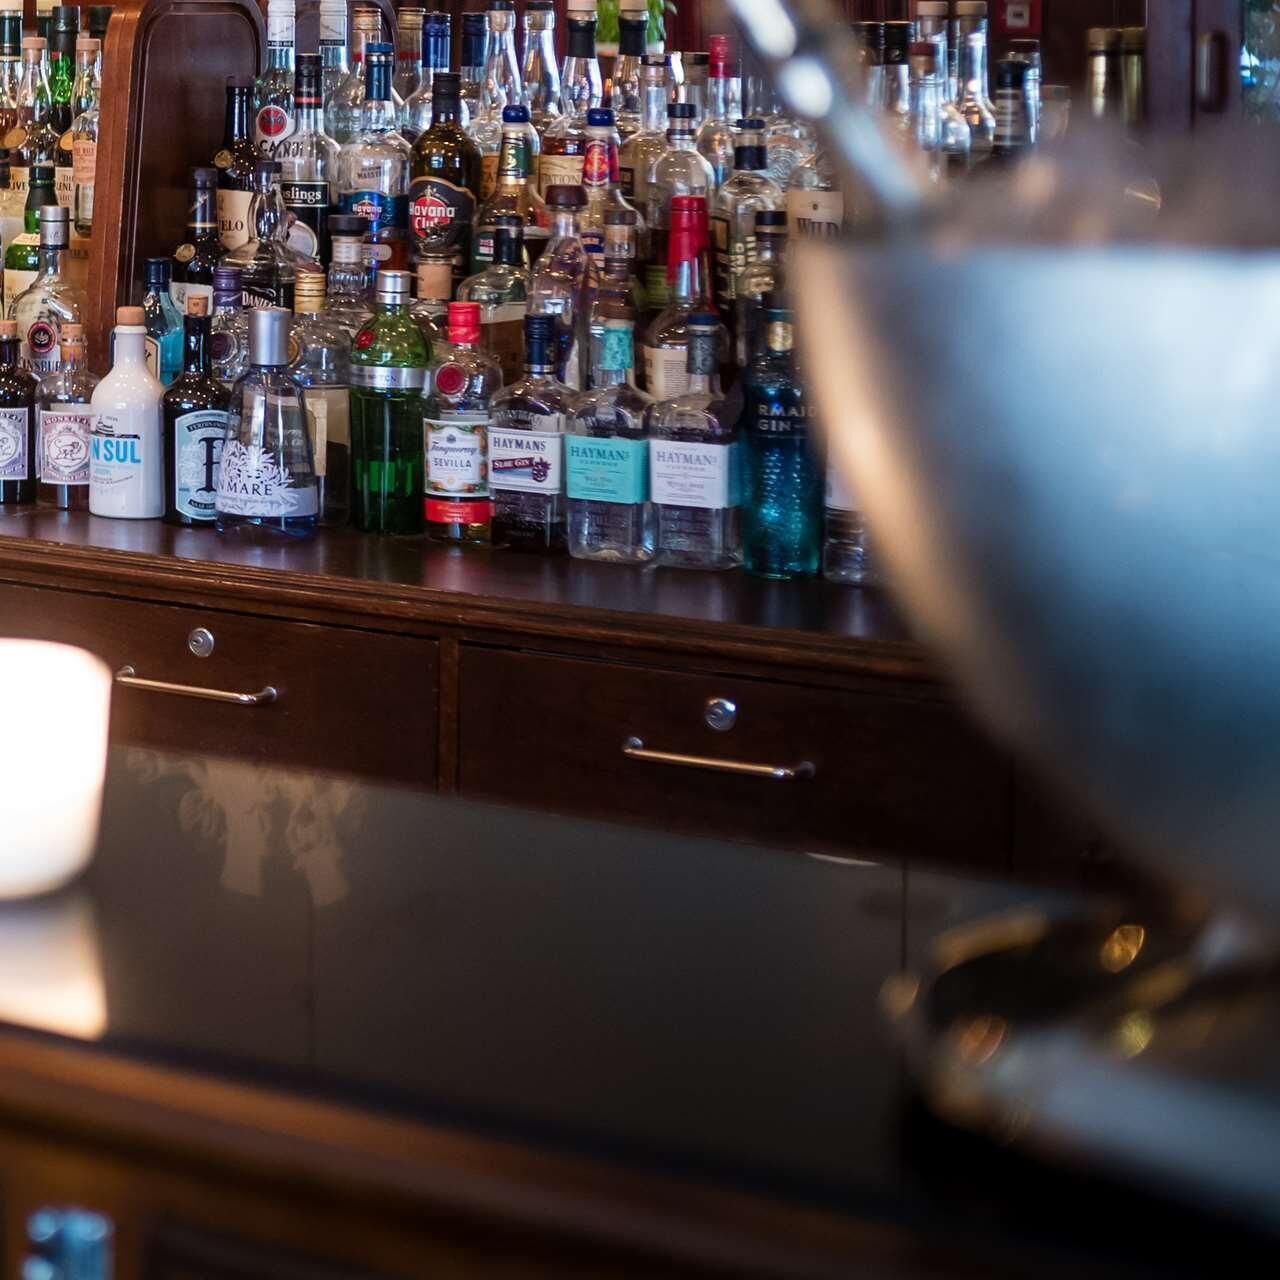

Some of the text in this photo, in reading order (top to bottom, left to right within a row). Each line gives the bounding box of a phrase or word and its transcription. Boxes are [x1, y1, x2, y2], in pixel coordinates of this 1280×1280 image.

[285, 186, 322, 203] slings
[408, 201, 456, 218] Havana
[757, 404, 817, 417] RMAID
[103, 438, 142, 464] SUL
[433, 457, 472, 468] SEVILLA
[228, 483, 273, 496] MARE
